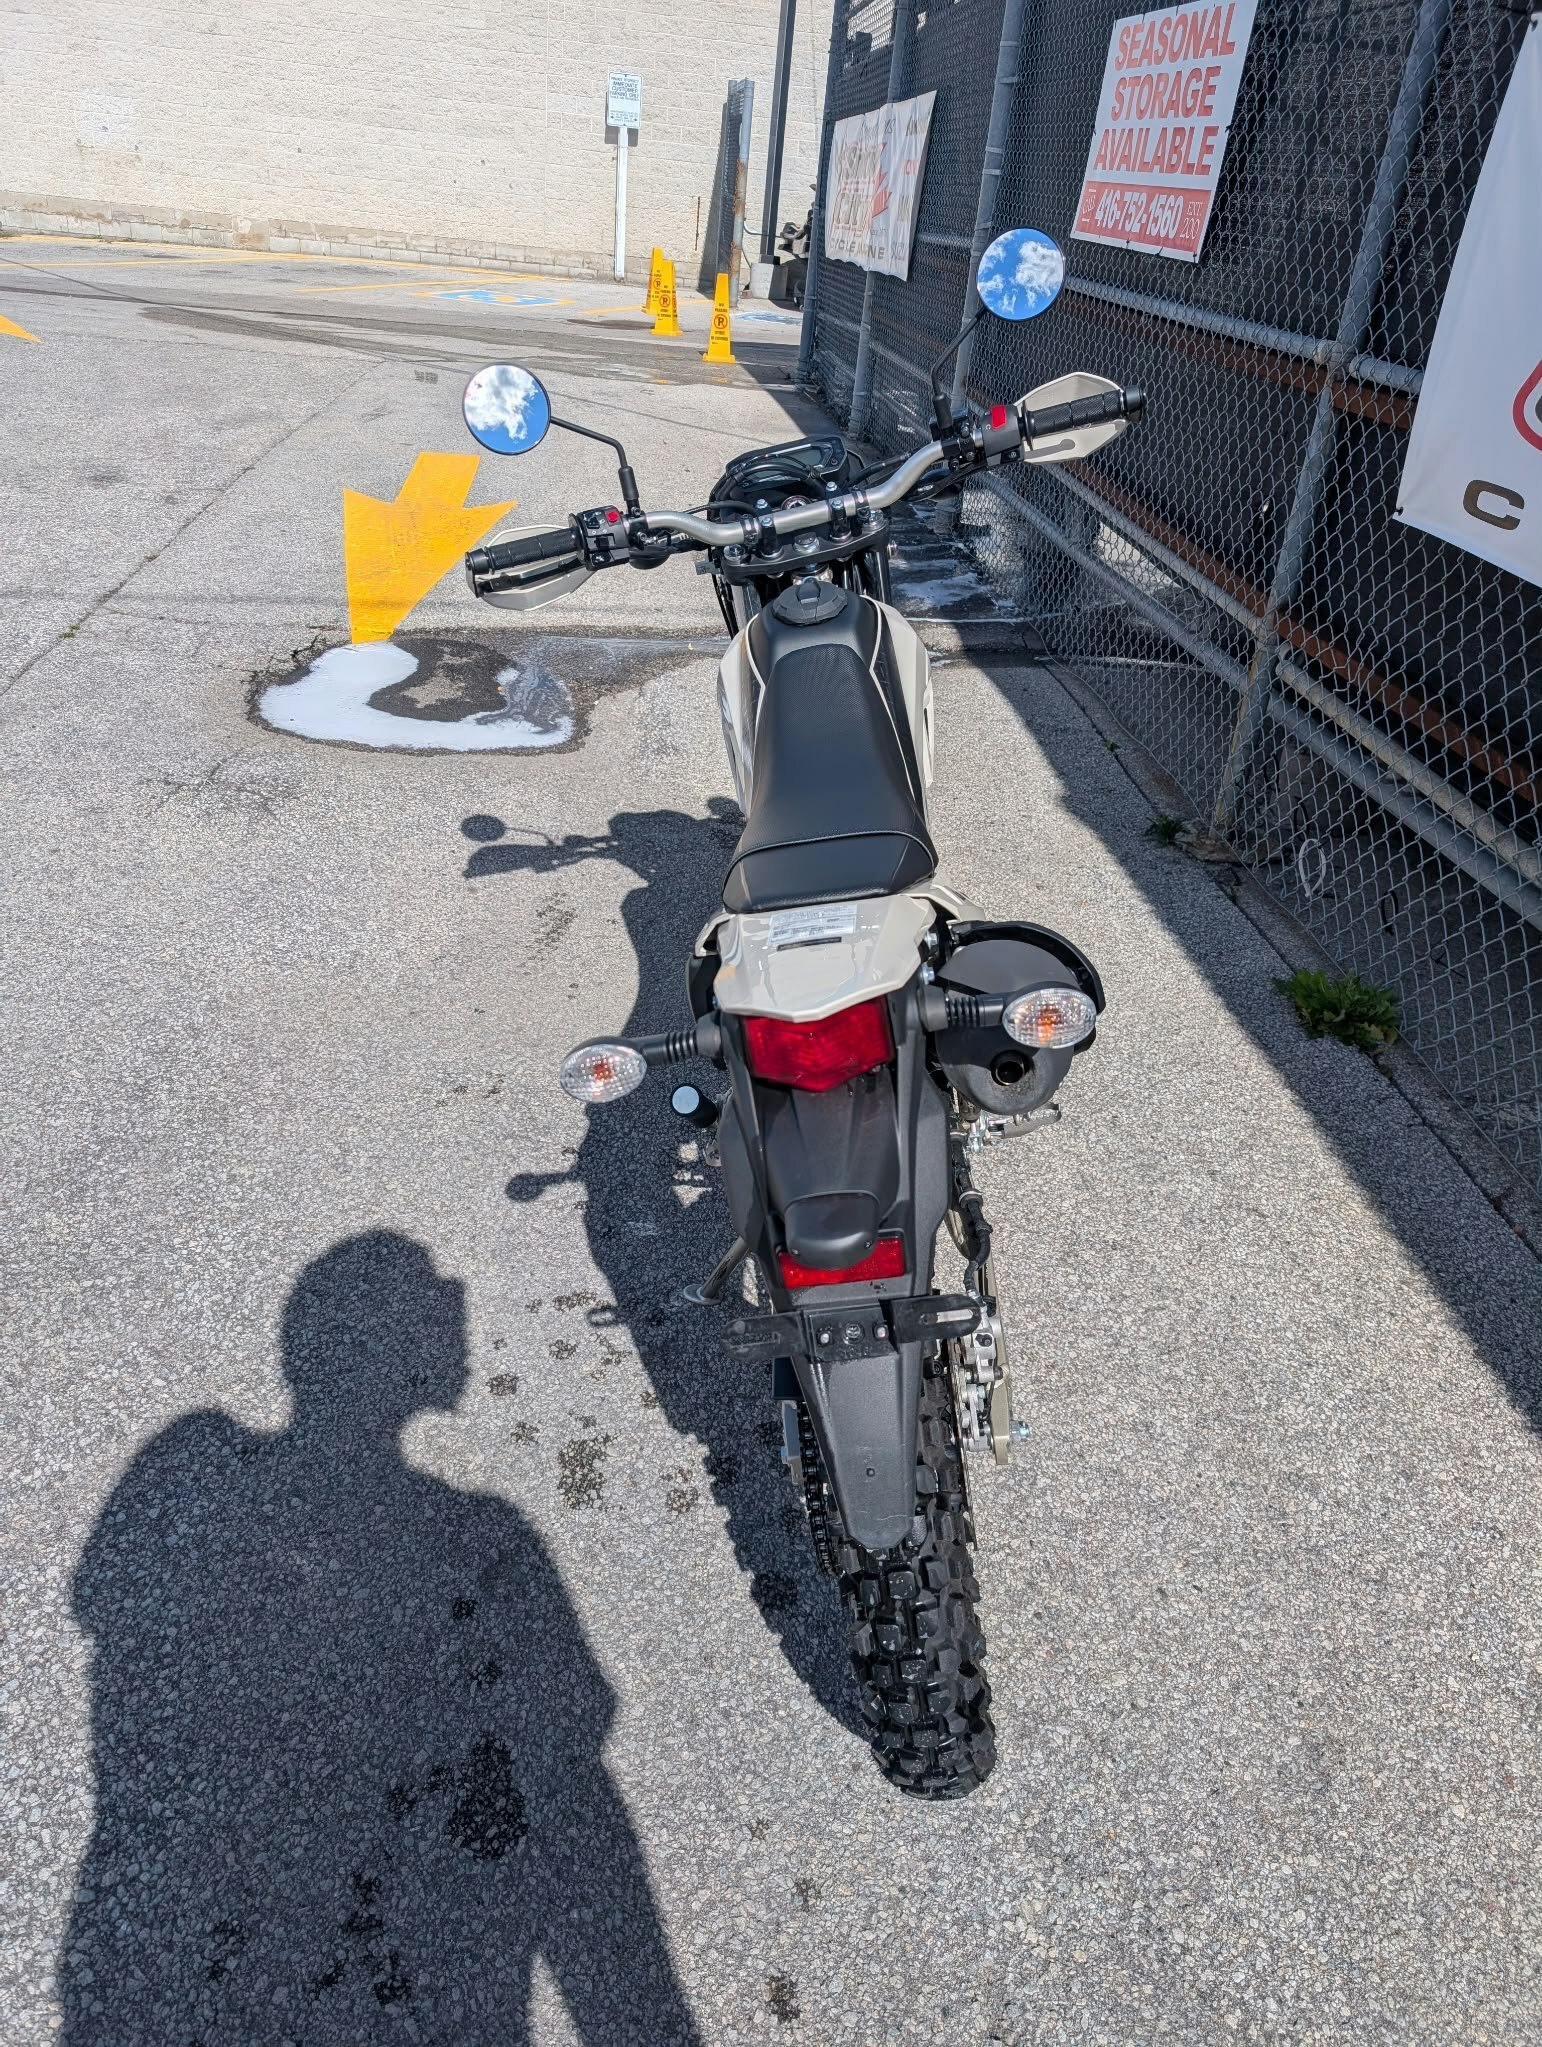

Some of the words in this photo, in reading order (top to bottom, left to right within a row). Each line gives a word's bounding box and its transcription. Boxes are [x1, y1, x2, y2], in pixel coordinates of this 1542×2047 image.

[1115, 3, 1236, 71] SEASONAL
[1111, 66, 1221, 121] STORAGE
[1093, 126, 1219, 176] AVAILABLE
[1095, 189, 1184, 239] 416-752-1560
[1180, 217, 1200, 239] 200
